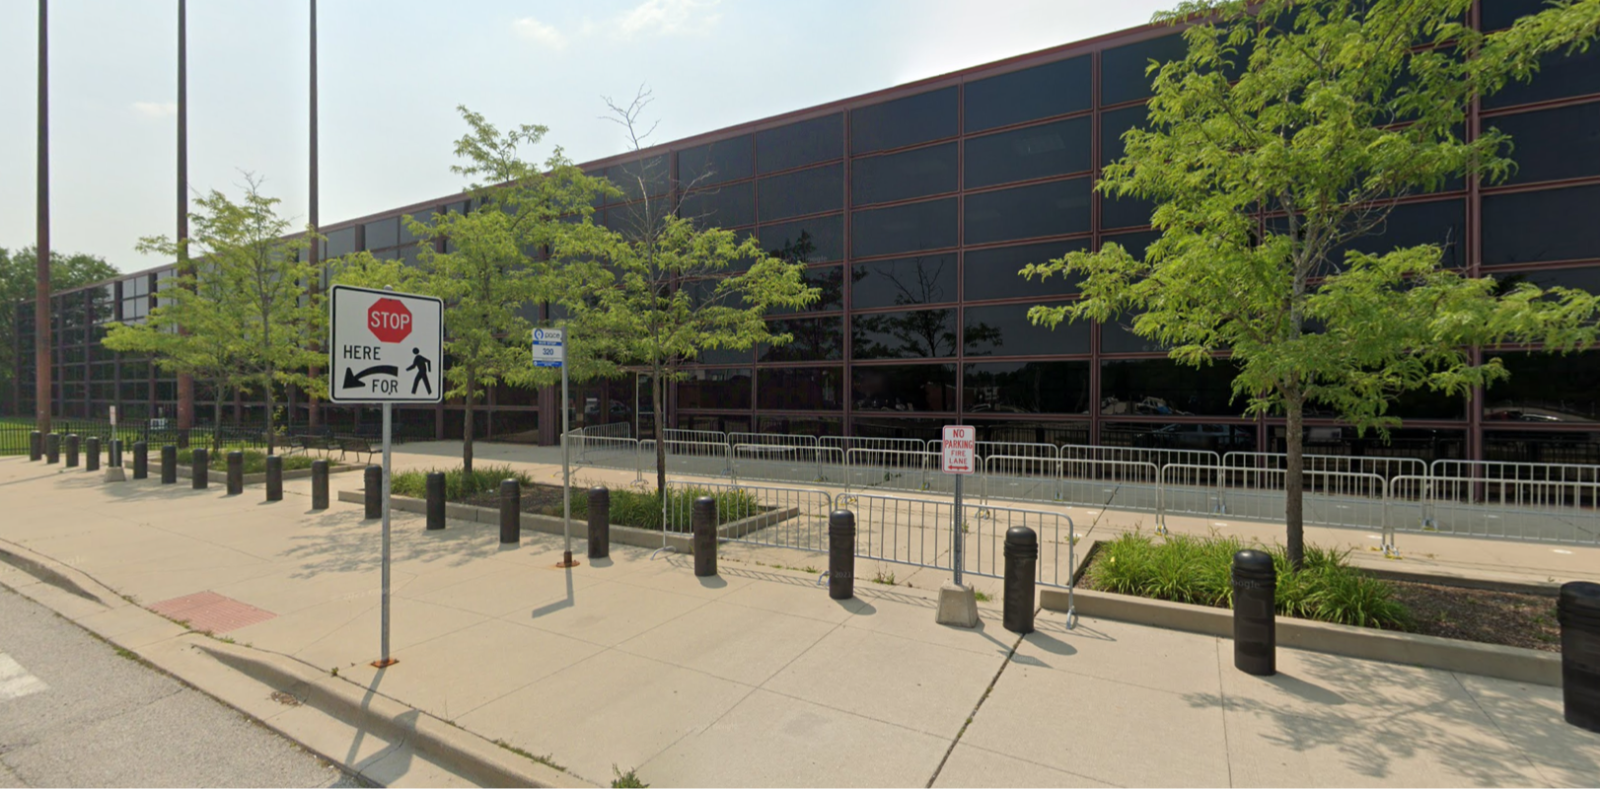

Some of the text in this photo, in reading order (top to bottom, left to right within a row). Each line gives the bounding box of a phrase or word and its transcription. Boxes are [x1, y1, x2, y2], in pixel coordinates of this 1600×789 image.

[370, 310, 410, 330] STOP
[343, 344, 381, 361] HERE
[542, 347, 554, 356] 320
[372, 378, 398, 393] FOR
[953, 429, 964, 438] NO
[944, 440, 973, 449] PARKING
